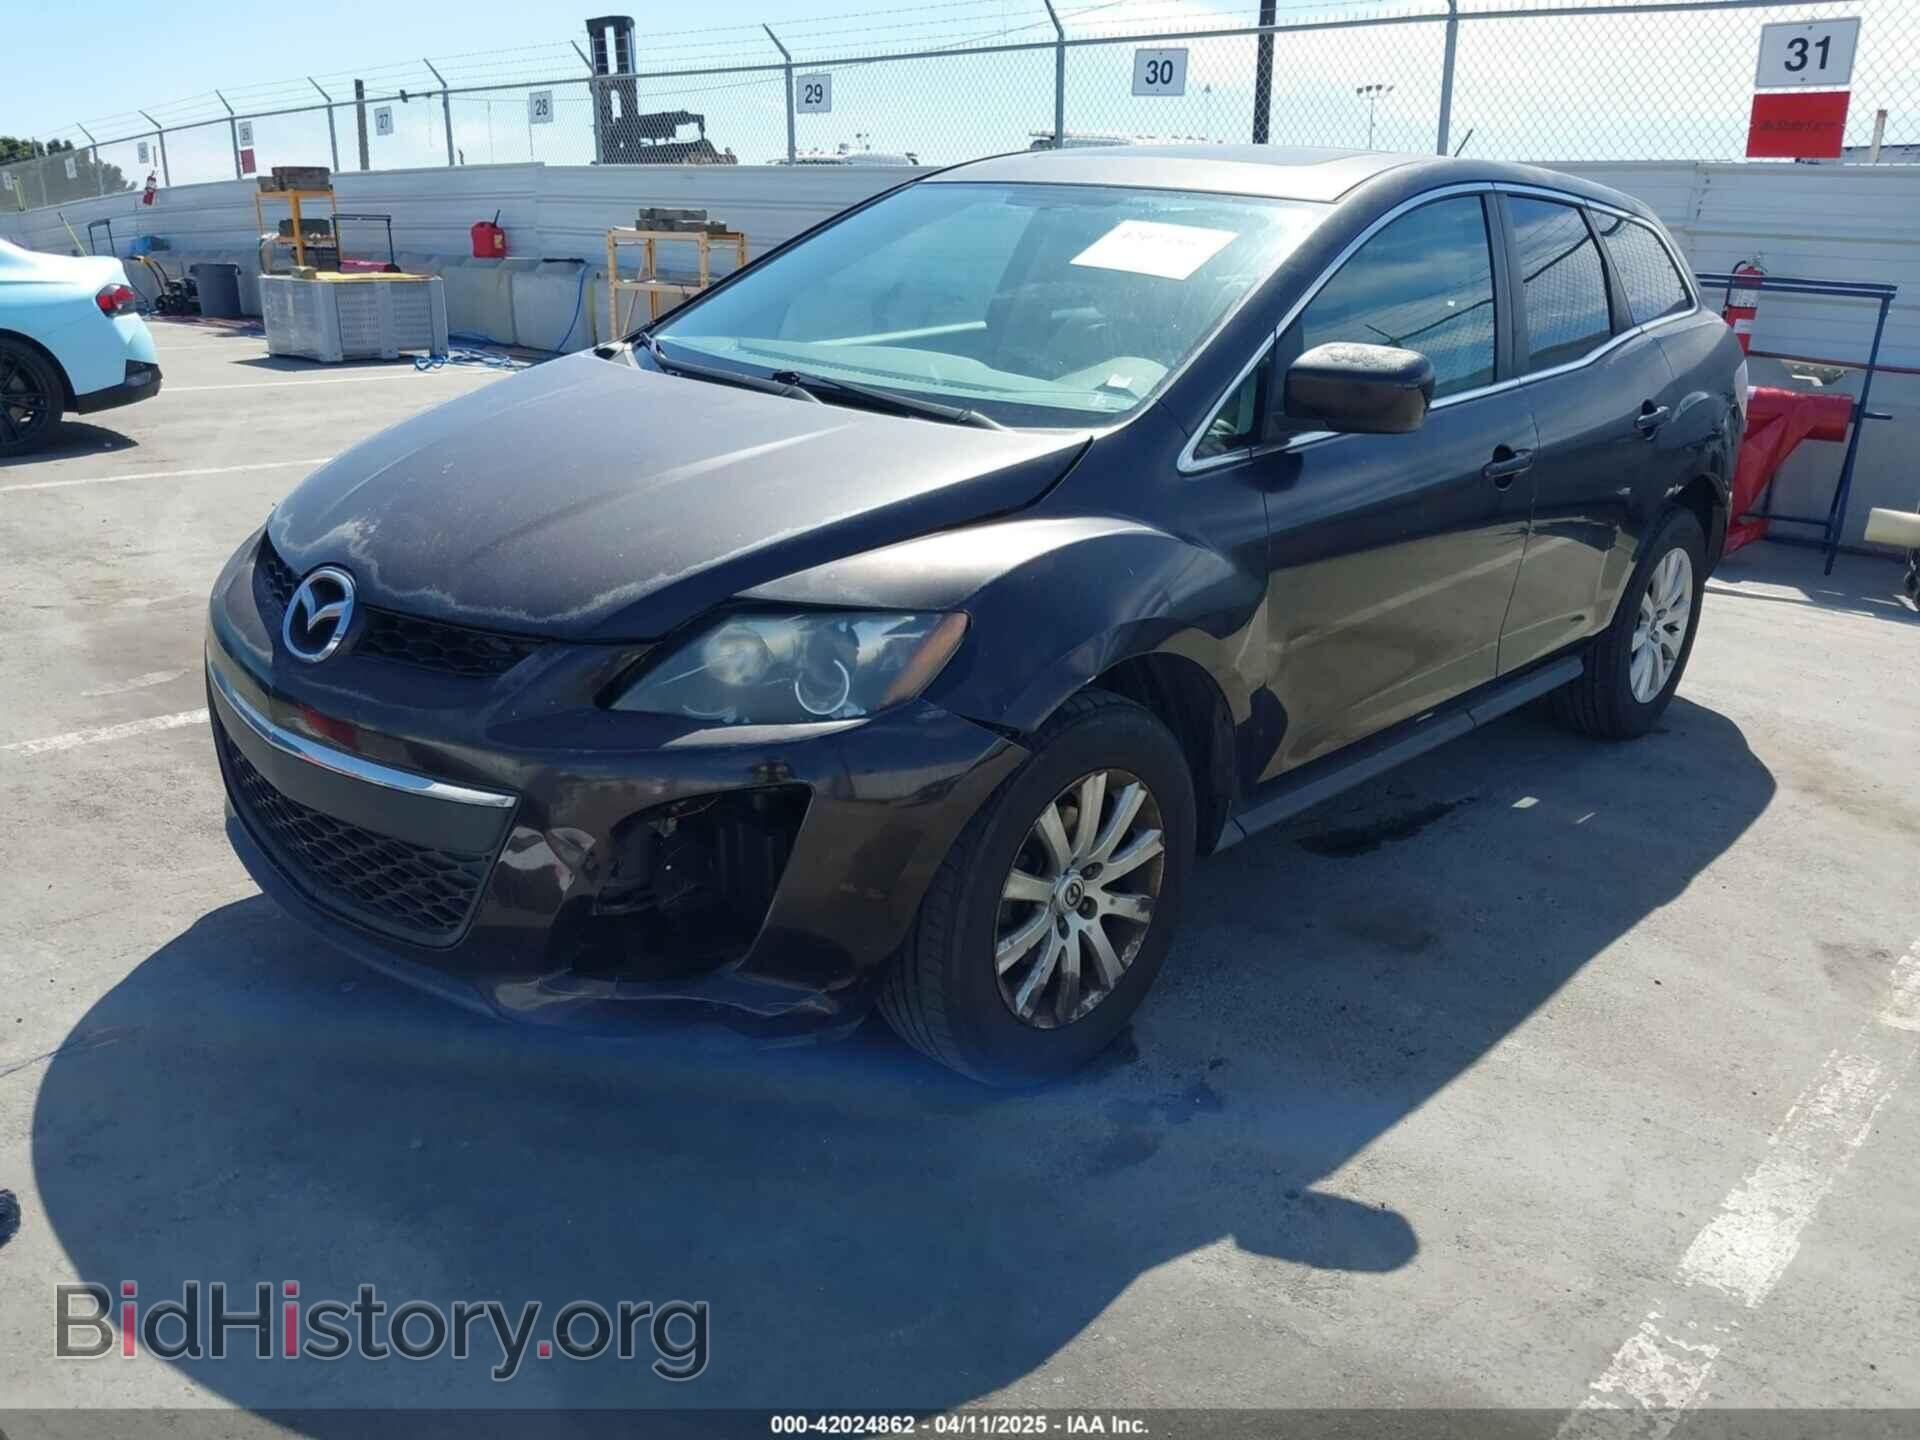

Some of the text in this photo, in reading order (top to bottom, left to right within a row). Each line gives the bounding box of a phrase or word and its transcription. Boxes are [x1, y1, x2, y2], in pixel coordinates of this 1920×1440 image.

[1784, 35, 1831, 72] 31
[1145, 60, 1173, 85] 30
[805, 83, 823, 104] 29
[535, 98, 548, 116] 28
